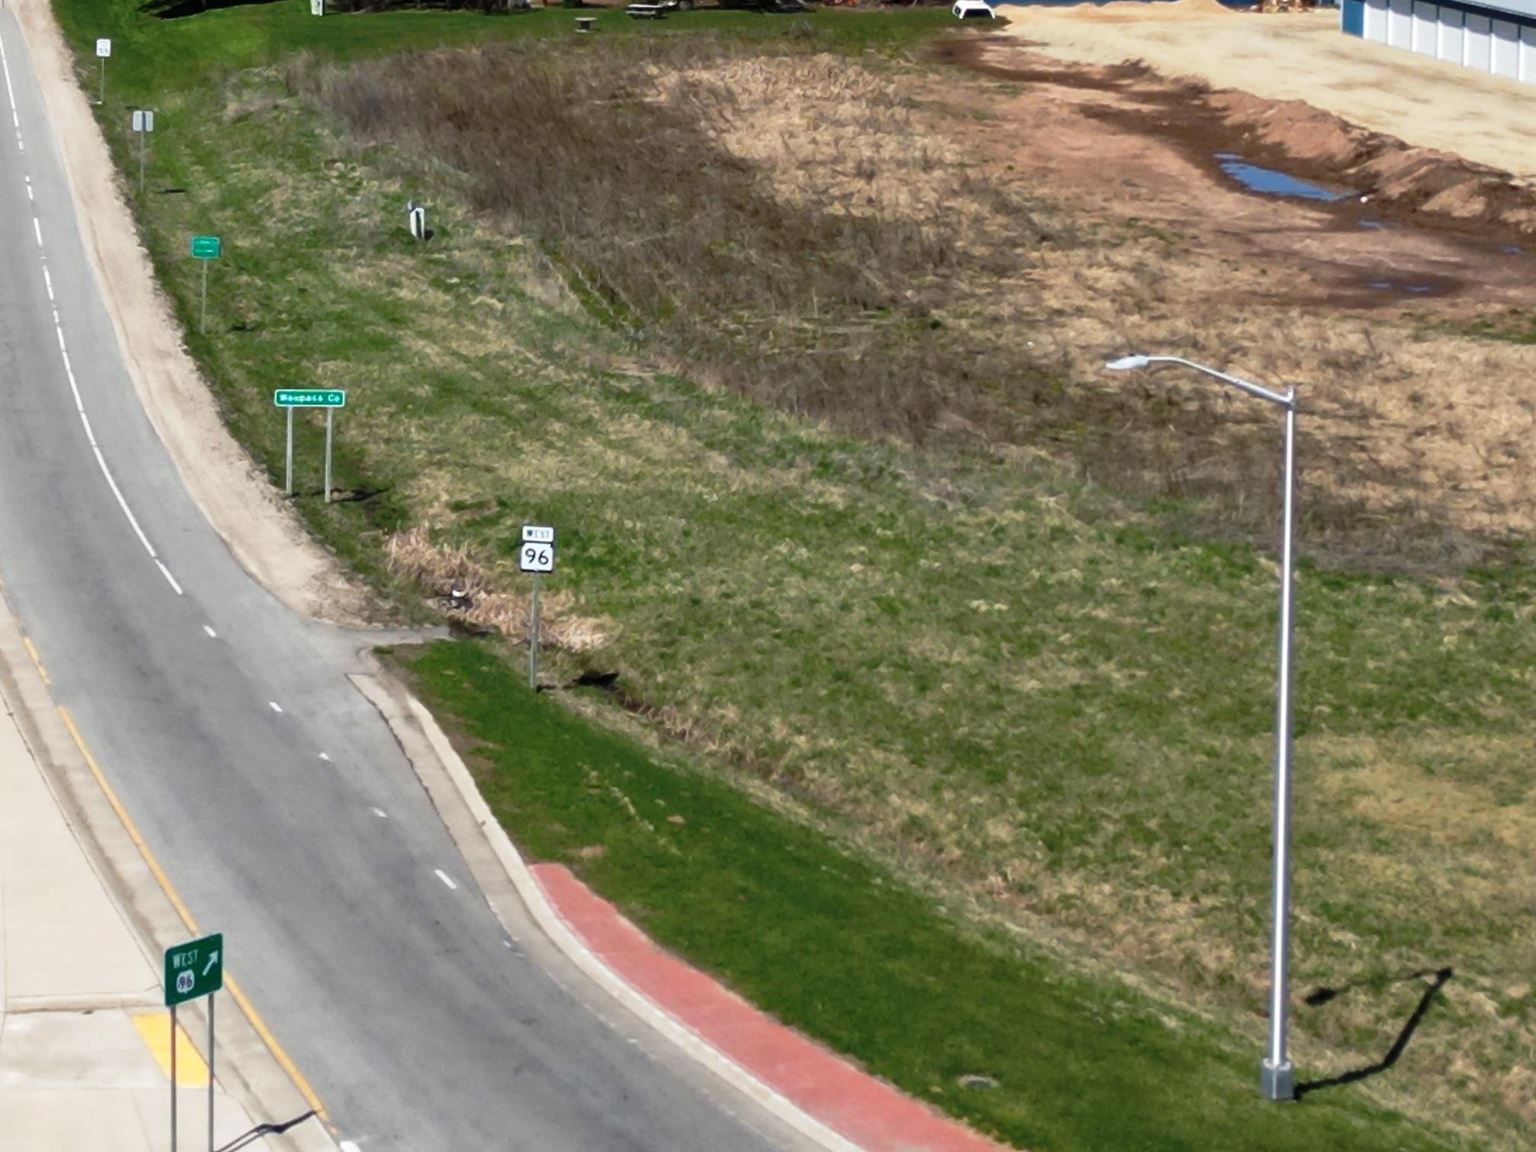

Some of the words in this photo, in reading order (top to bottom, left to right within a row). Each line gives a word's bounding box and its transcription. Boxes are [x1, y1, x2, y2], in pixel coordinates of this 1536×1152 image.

[328, 394, 341, 402] Co
[525, 548, 549, 565] 96
[173, 949, 199, 968] WEST
[178, 974, 193, 990] 96
